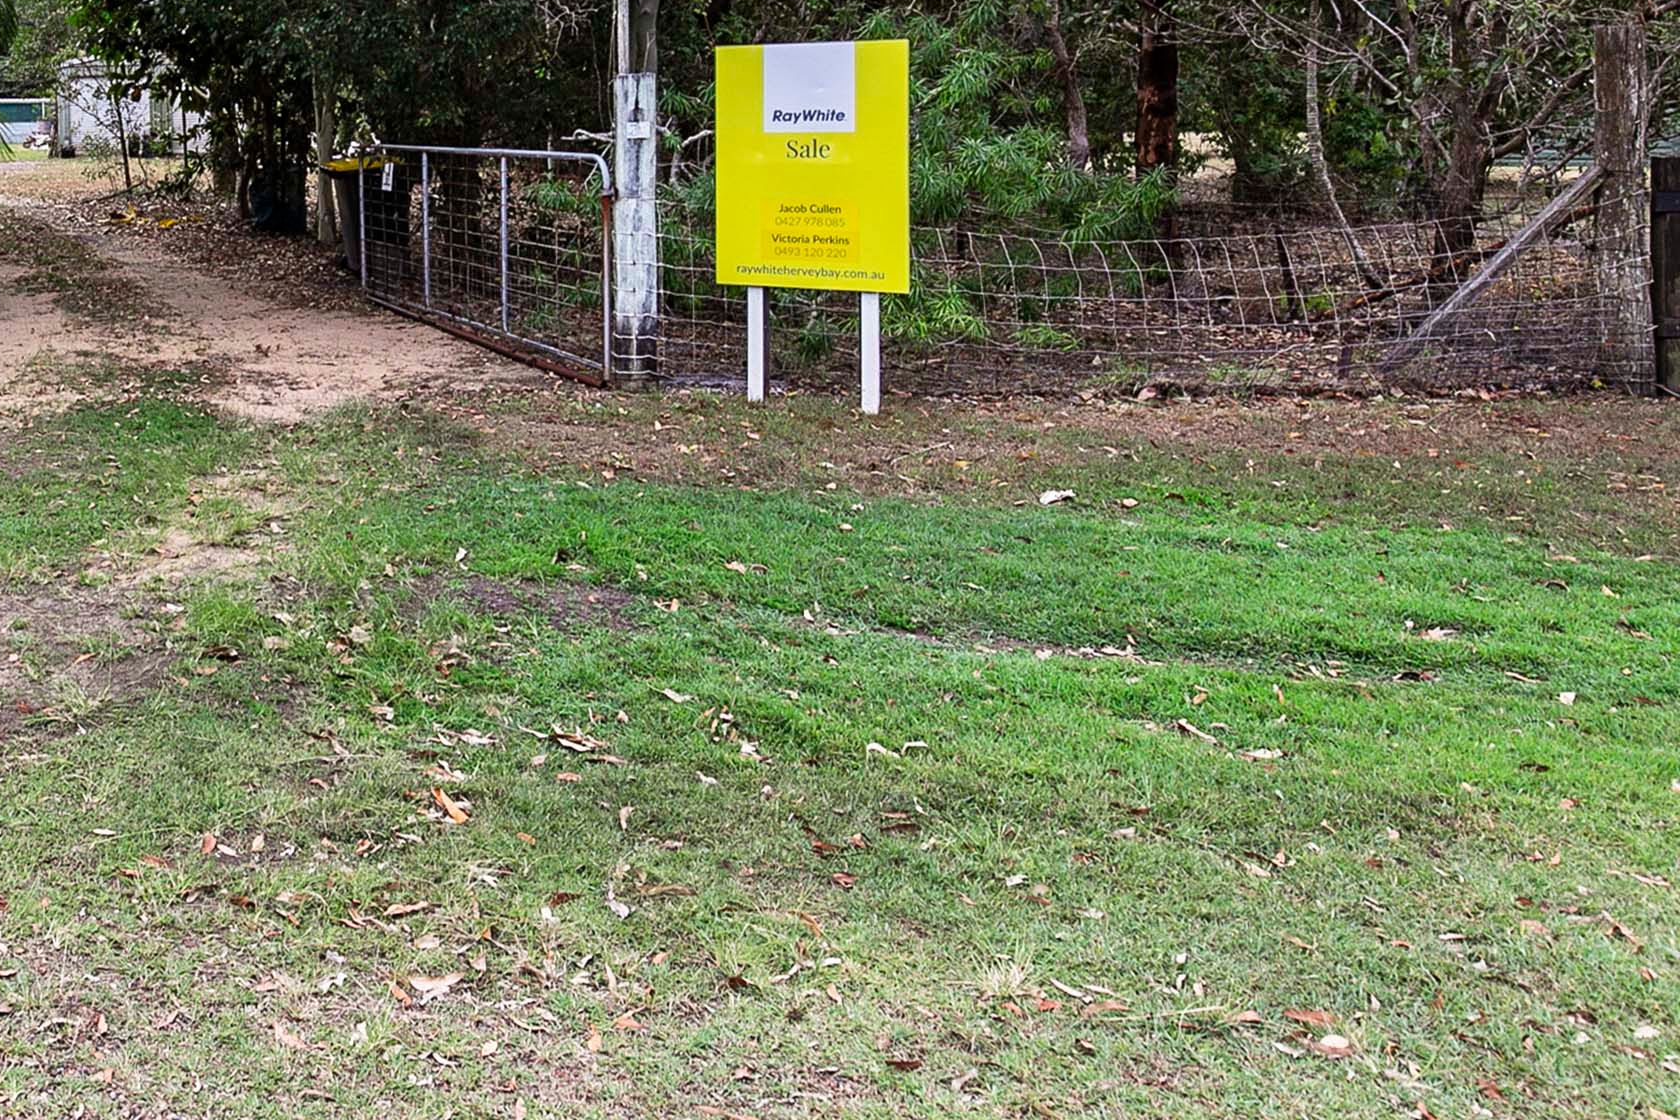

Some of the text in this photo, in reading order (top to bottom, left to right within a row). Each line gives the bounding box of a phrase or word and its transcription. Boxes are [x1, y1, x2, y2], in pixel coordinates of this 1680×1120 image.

[786, 138, 831, 159] Sale
[778, 203, 842, 214] Jacob Cullen
[775, 216, 801, 226] 0427
[803, 217, 824, 227] 978
[771, 233, 850, 245] Victoria Perkins
[825, 248, 847, 258] 220
[736, 262, 886, 281] raywhiteherveybay.com.au
